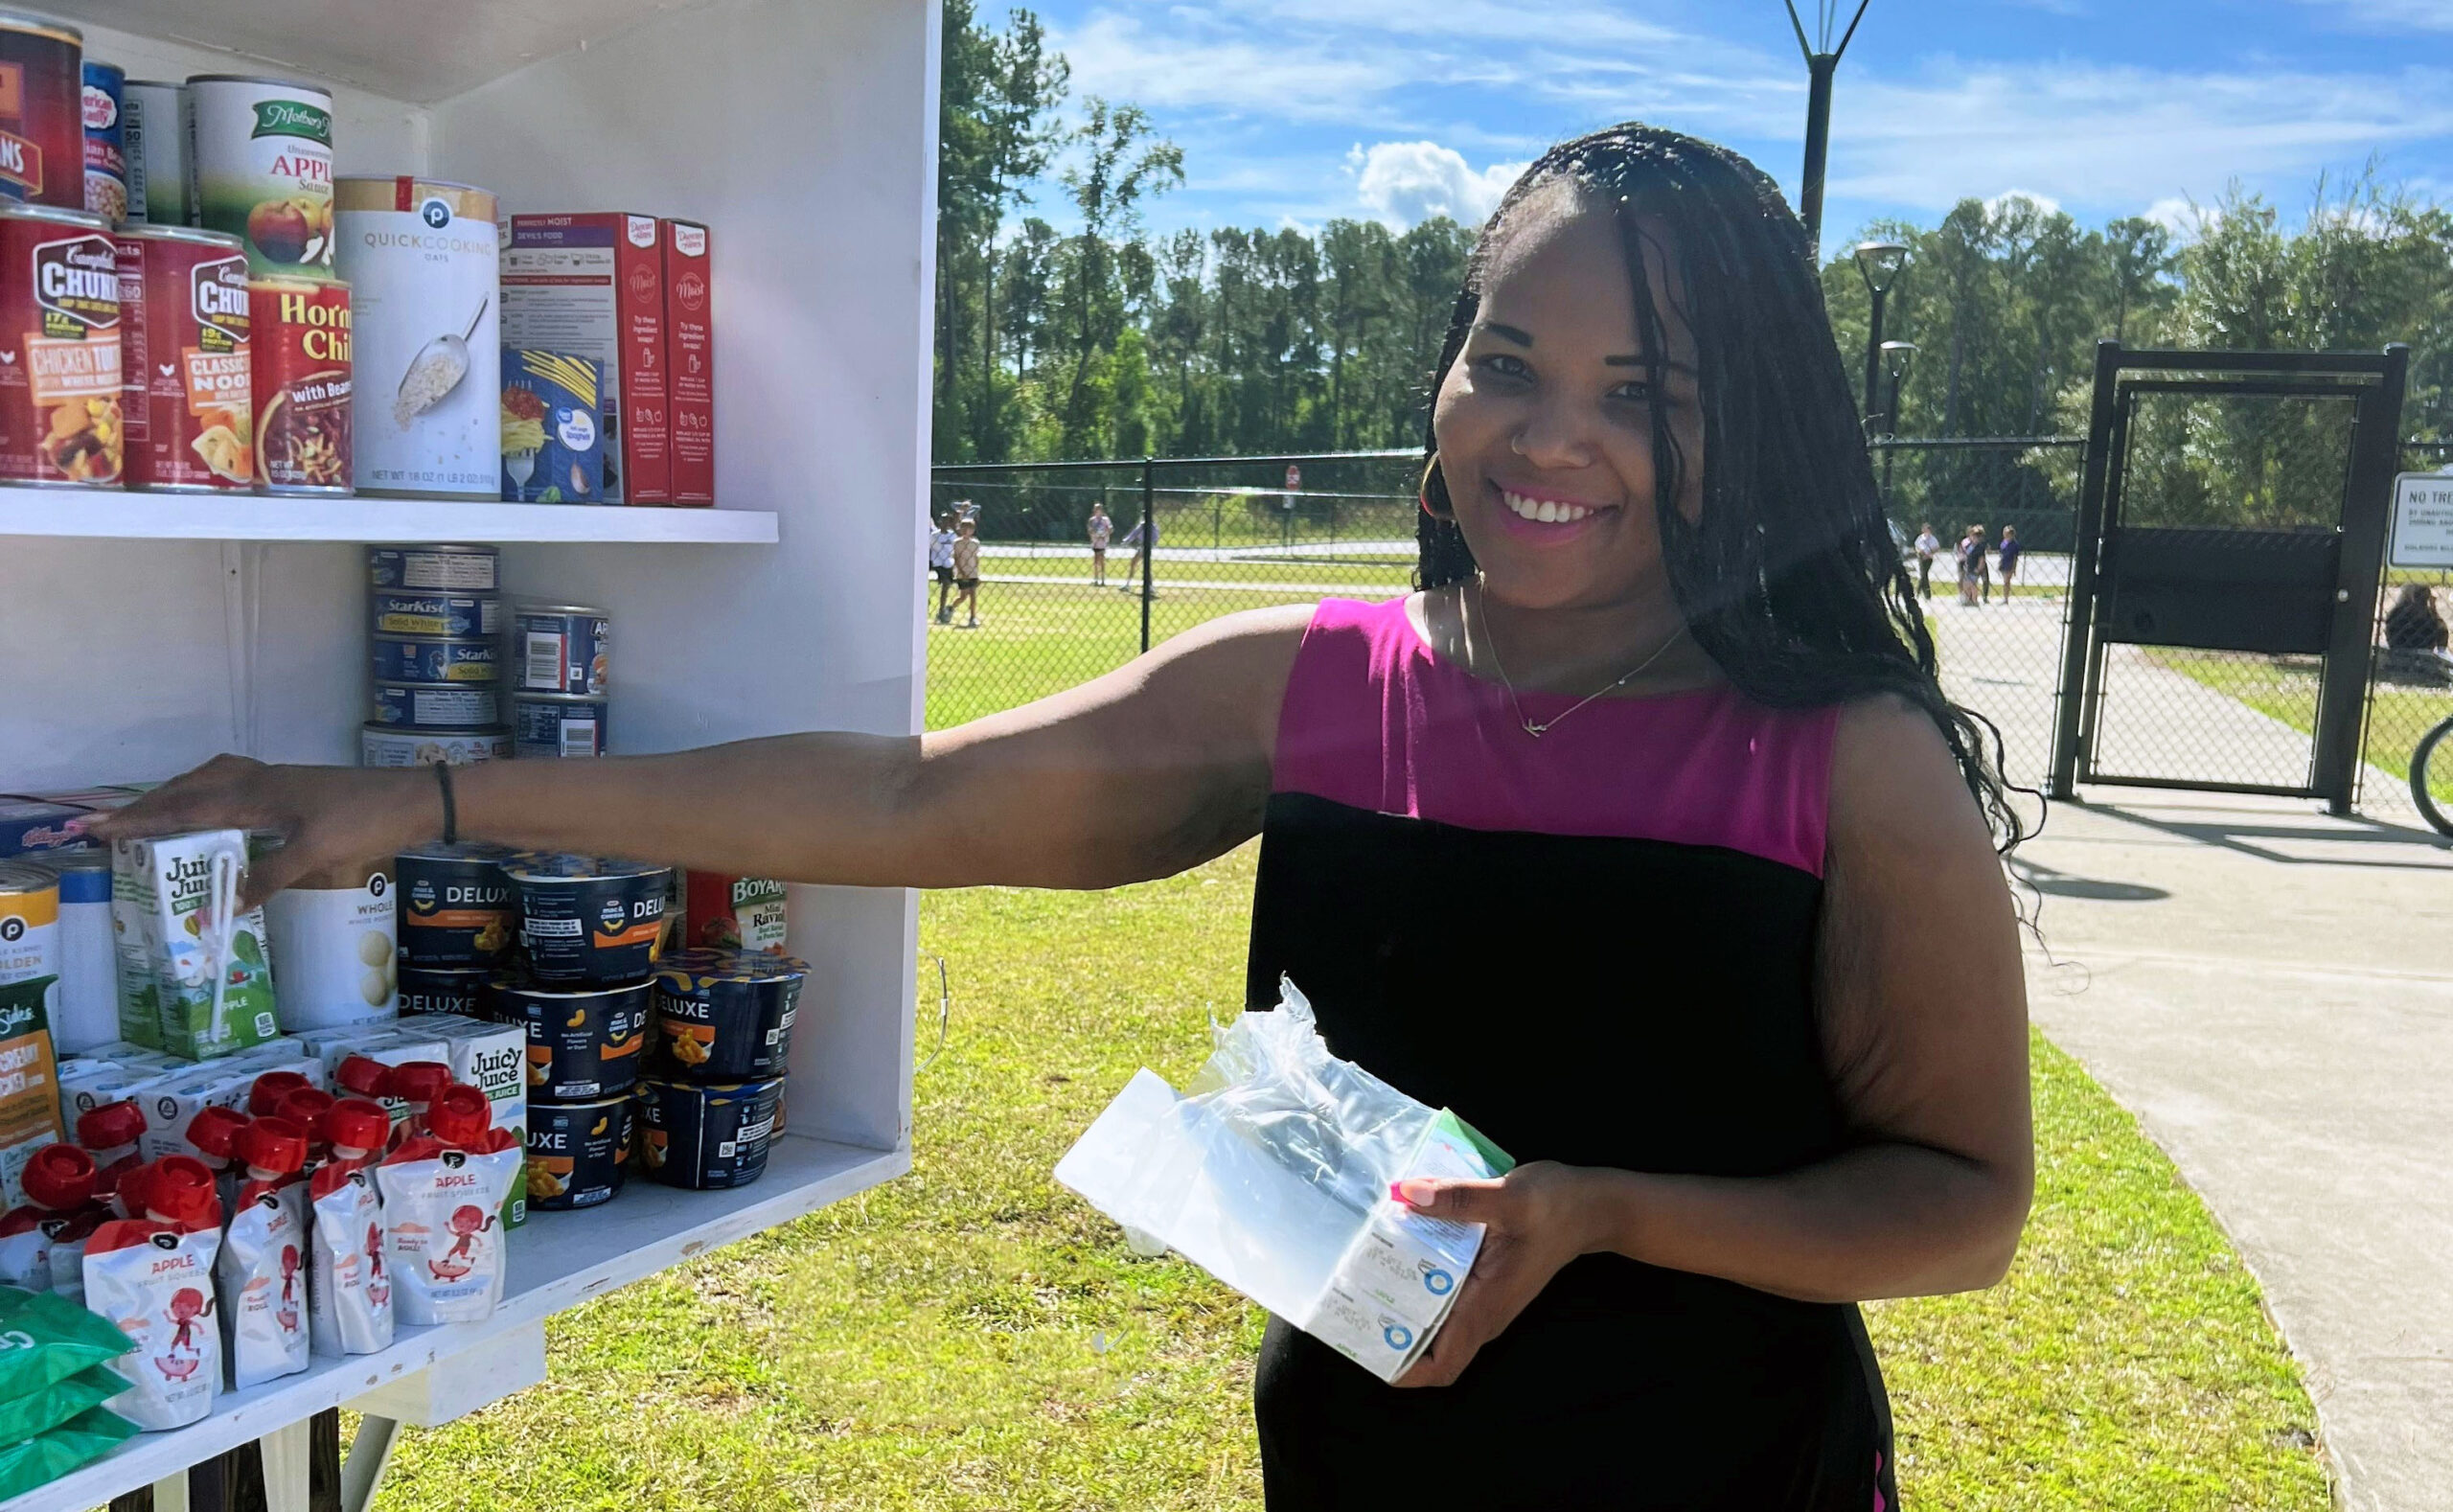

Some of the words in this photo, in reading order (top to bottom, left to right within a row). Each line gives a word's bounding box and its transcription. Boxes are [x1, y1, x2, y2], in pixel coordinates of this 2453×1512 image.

[547, 217, 572, 226] MOIST
[543, 231, 563, 241] FOOD
[677, 230, 703, 241] Duncan
[364, 233, 422, 249] QUICK
[422, 235, 492, 256] COOKING
[424, 253, 449, 263] OATS
[676, 282, 704, 300] Moist
[31, 346, 92, 376] CHICKEN
[292, 384, 327, 403] with
[372, 470, 388, 480] NET
[390, 470, 404, 480] WT
[2409, 490, 2426, 504] NO
[388, 599, 445, 613] StarKist
[357, 901, 394, 915] WHOLE
[399, 994, 477, 1013] DELUXE
[471, 1046, 523, 1076] Juicy
[475, 1068, 518, 1090] Juice
[493, 1087, 518, 1100] JUICE
[435, 1174, 477, 1188] APPLE
[422, 1189, 449, 1199] FRUIT
[450, 1185, 491, 1198] SQUEEZE
[151, 1253, 195, 1274] APPLE
